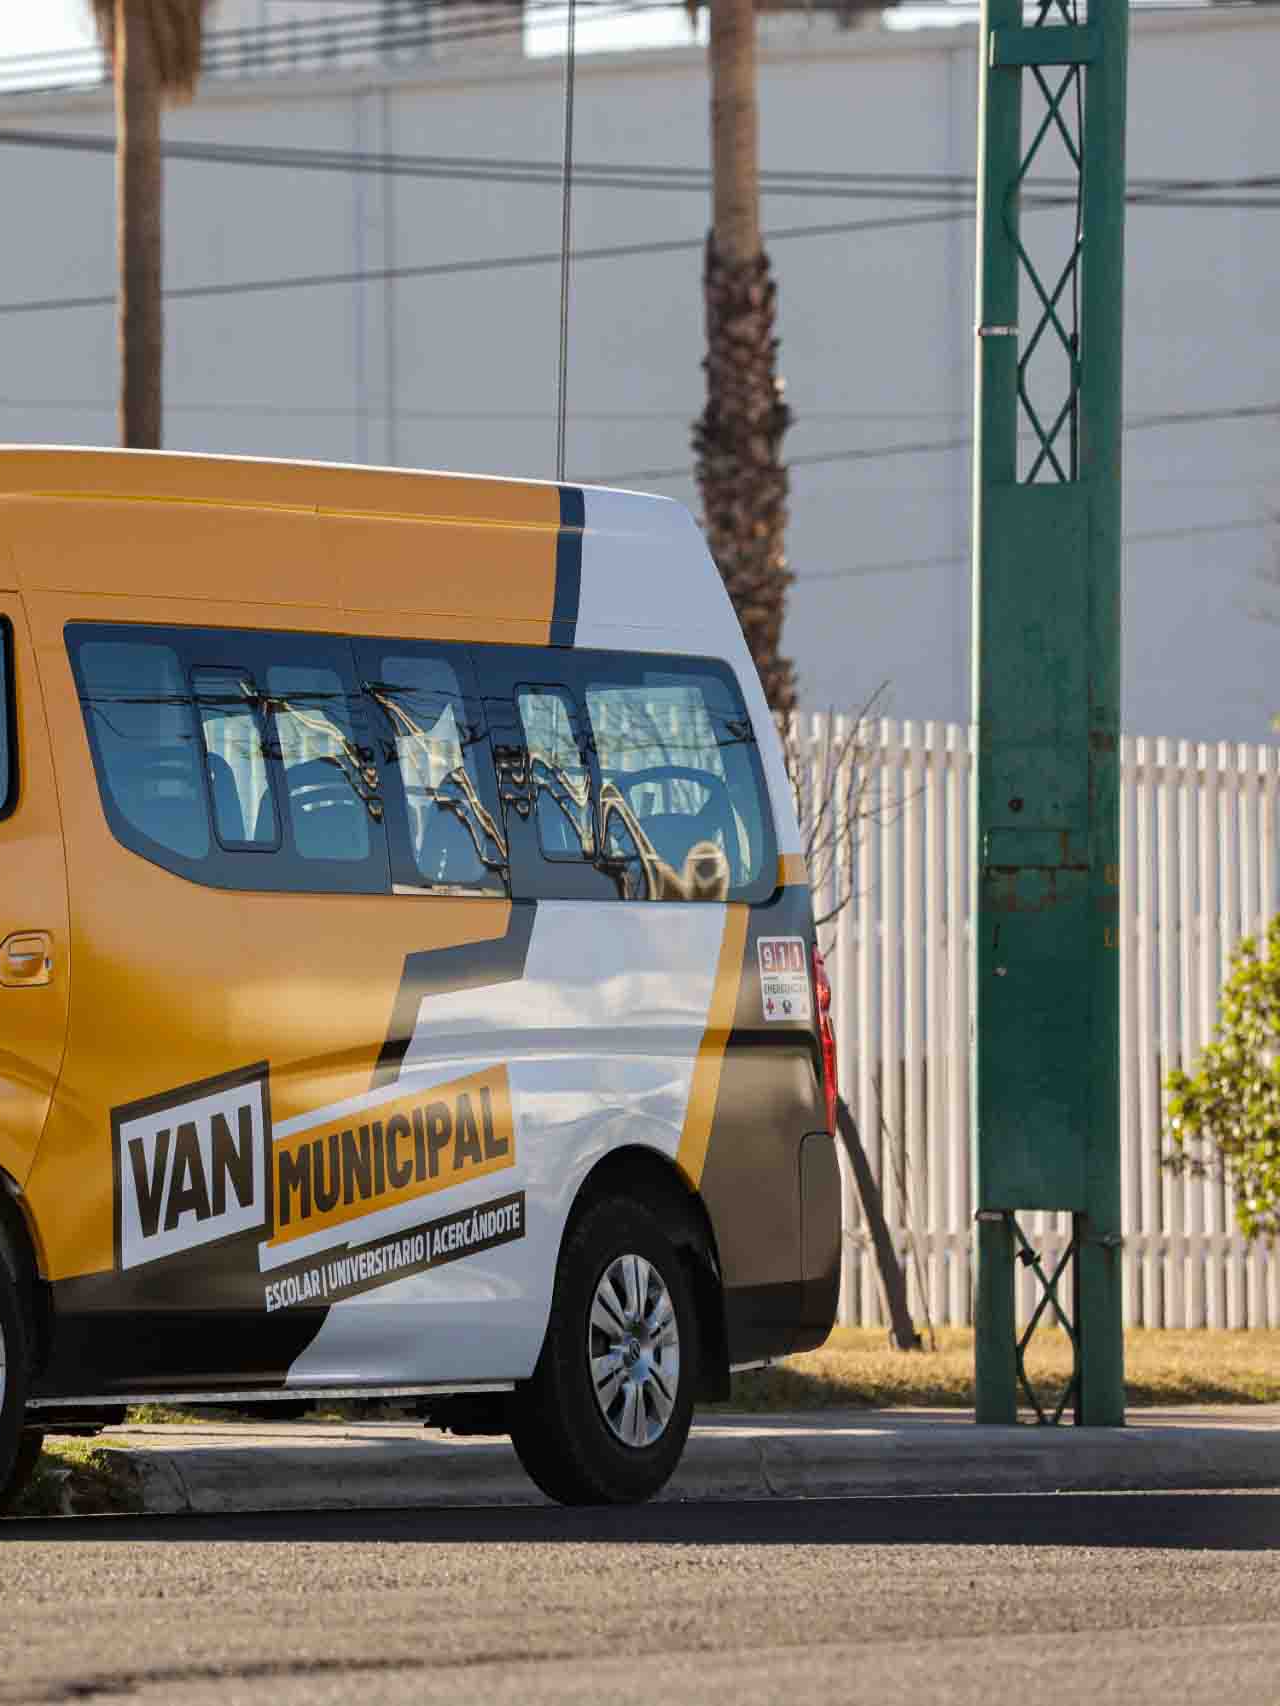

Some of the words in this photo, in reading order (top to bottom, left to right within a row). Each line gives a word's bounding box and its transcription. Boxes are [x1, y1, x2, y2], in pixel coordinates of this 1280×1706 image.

[127, 1103, 256, 1240] VAN
[276, 1086, 510, 1226] MUNICIPAL
[265, 1273, 321, 1313] ESCOLAR
[328, 1234, 425, 1290] UNIVERSITARIO
[432, 1200, 521, 1259] ACERCÁNDOTE
